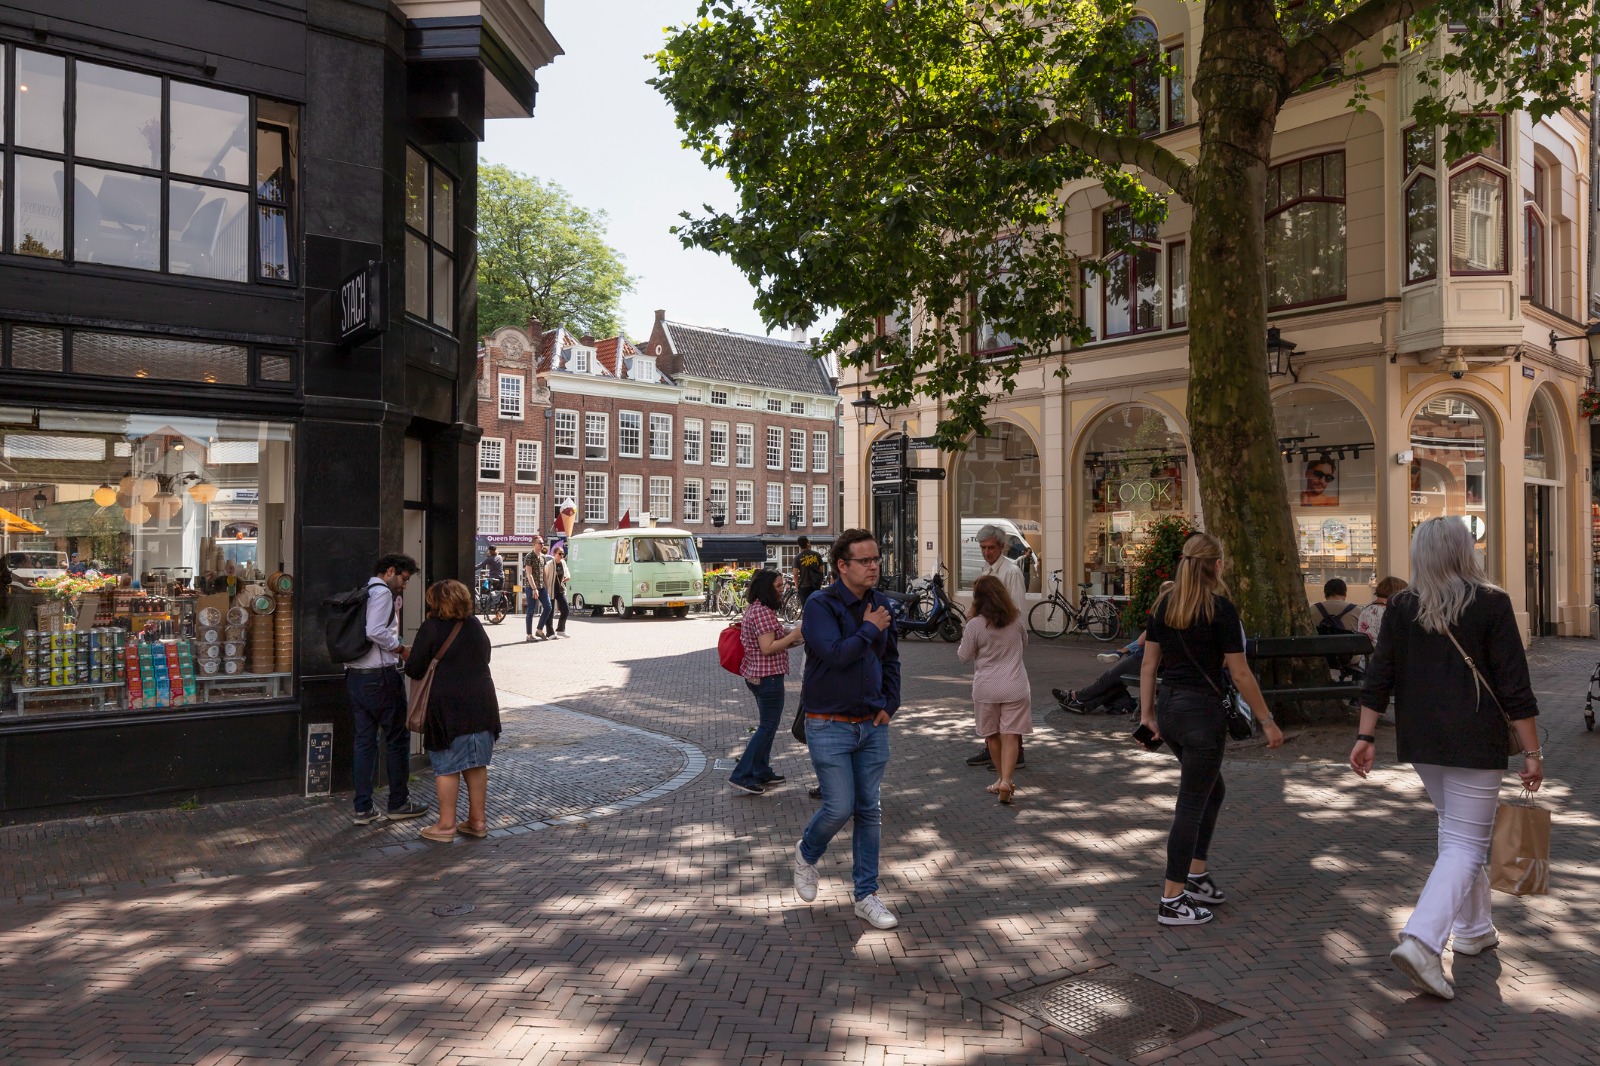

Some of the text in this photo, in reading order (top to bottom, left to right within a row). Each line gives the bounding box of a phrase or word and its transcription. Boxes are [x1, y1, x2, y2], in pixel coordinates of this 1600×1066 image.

[342, 271, 366, 332] STACH
[1107, 482, 1171, 503] LOOK
[508, 535, 533, 543] Piercing
